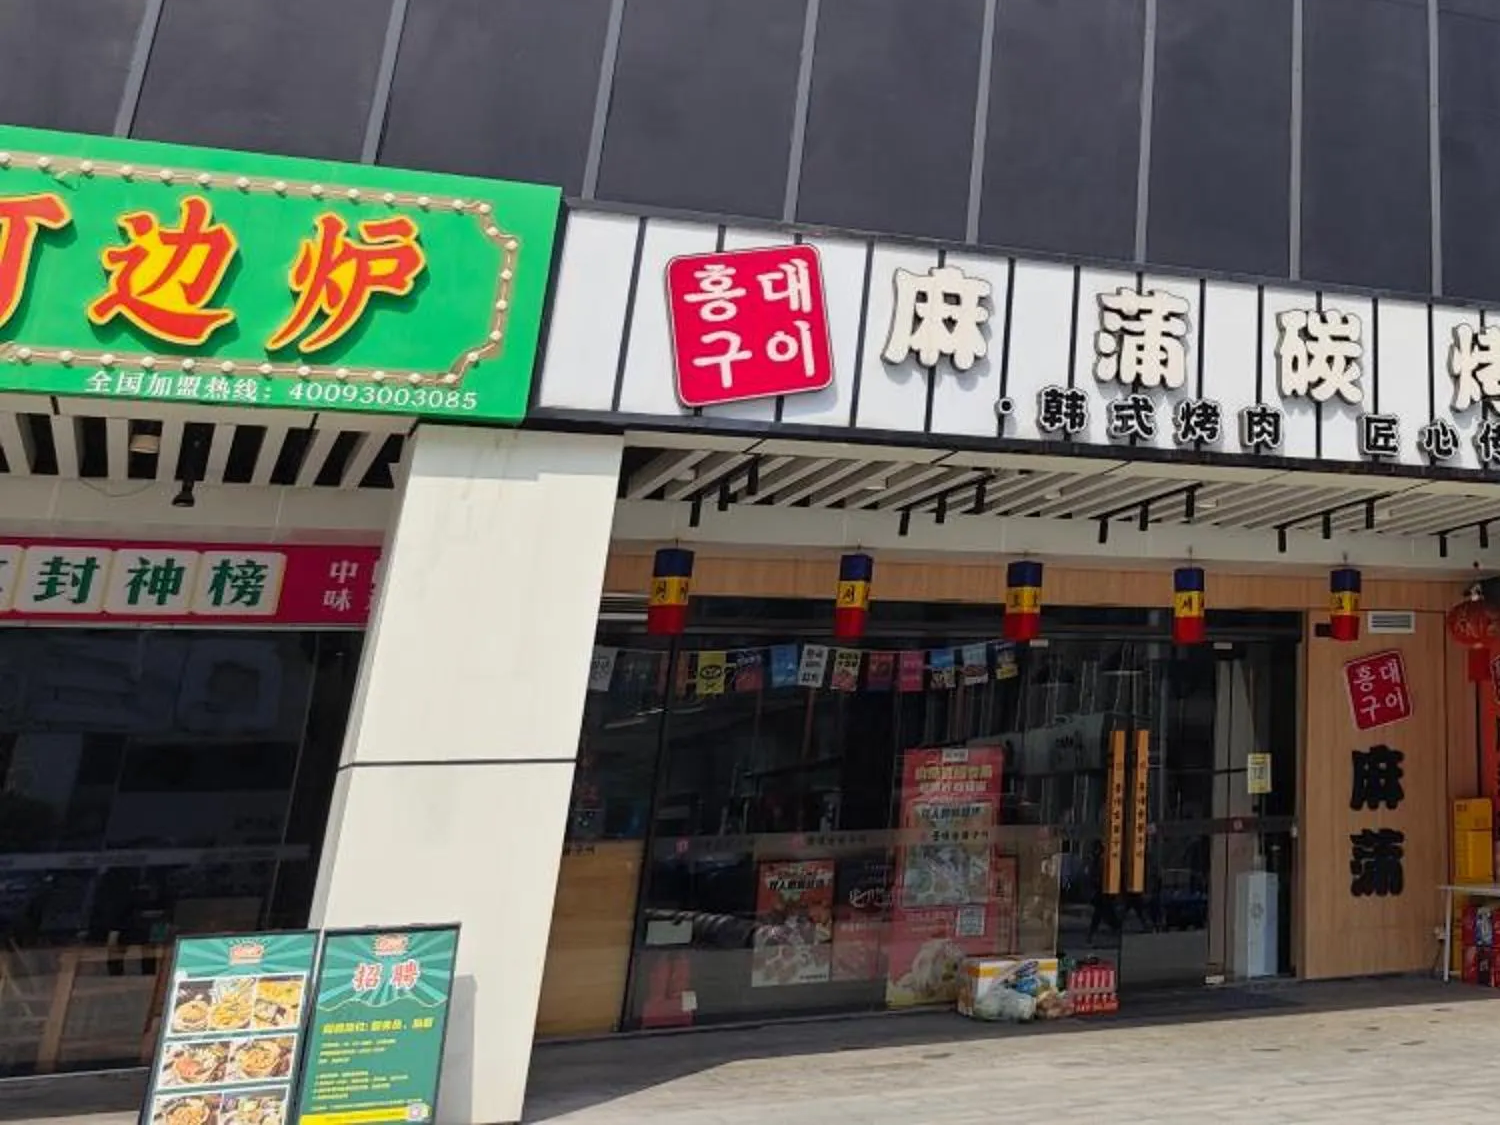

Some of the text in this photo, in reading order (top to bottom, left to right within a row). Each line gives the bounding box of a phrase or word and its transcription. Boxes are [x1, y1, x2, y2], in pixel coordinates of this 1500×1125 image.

[684, 258, 813, 323] 홍대
[692, 320, 815, 389] 구이
[0, 555, 271, 608] 封神榜
[1350, 744, 1405, 897] 麻蒲
